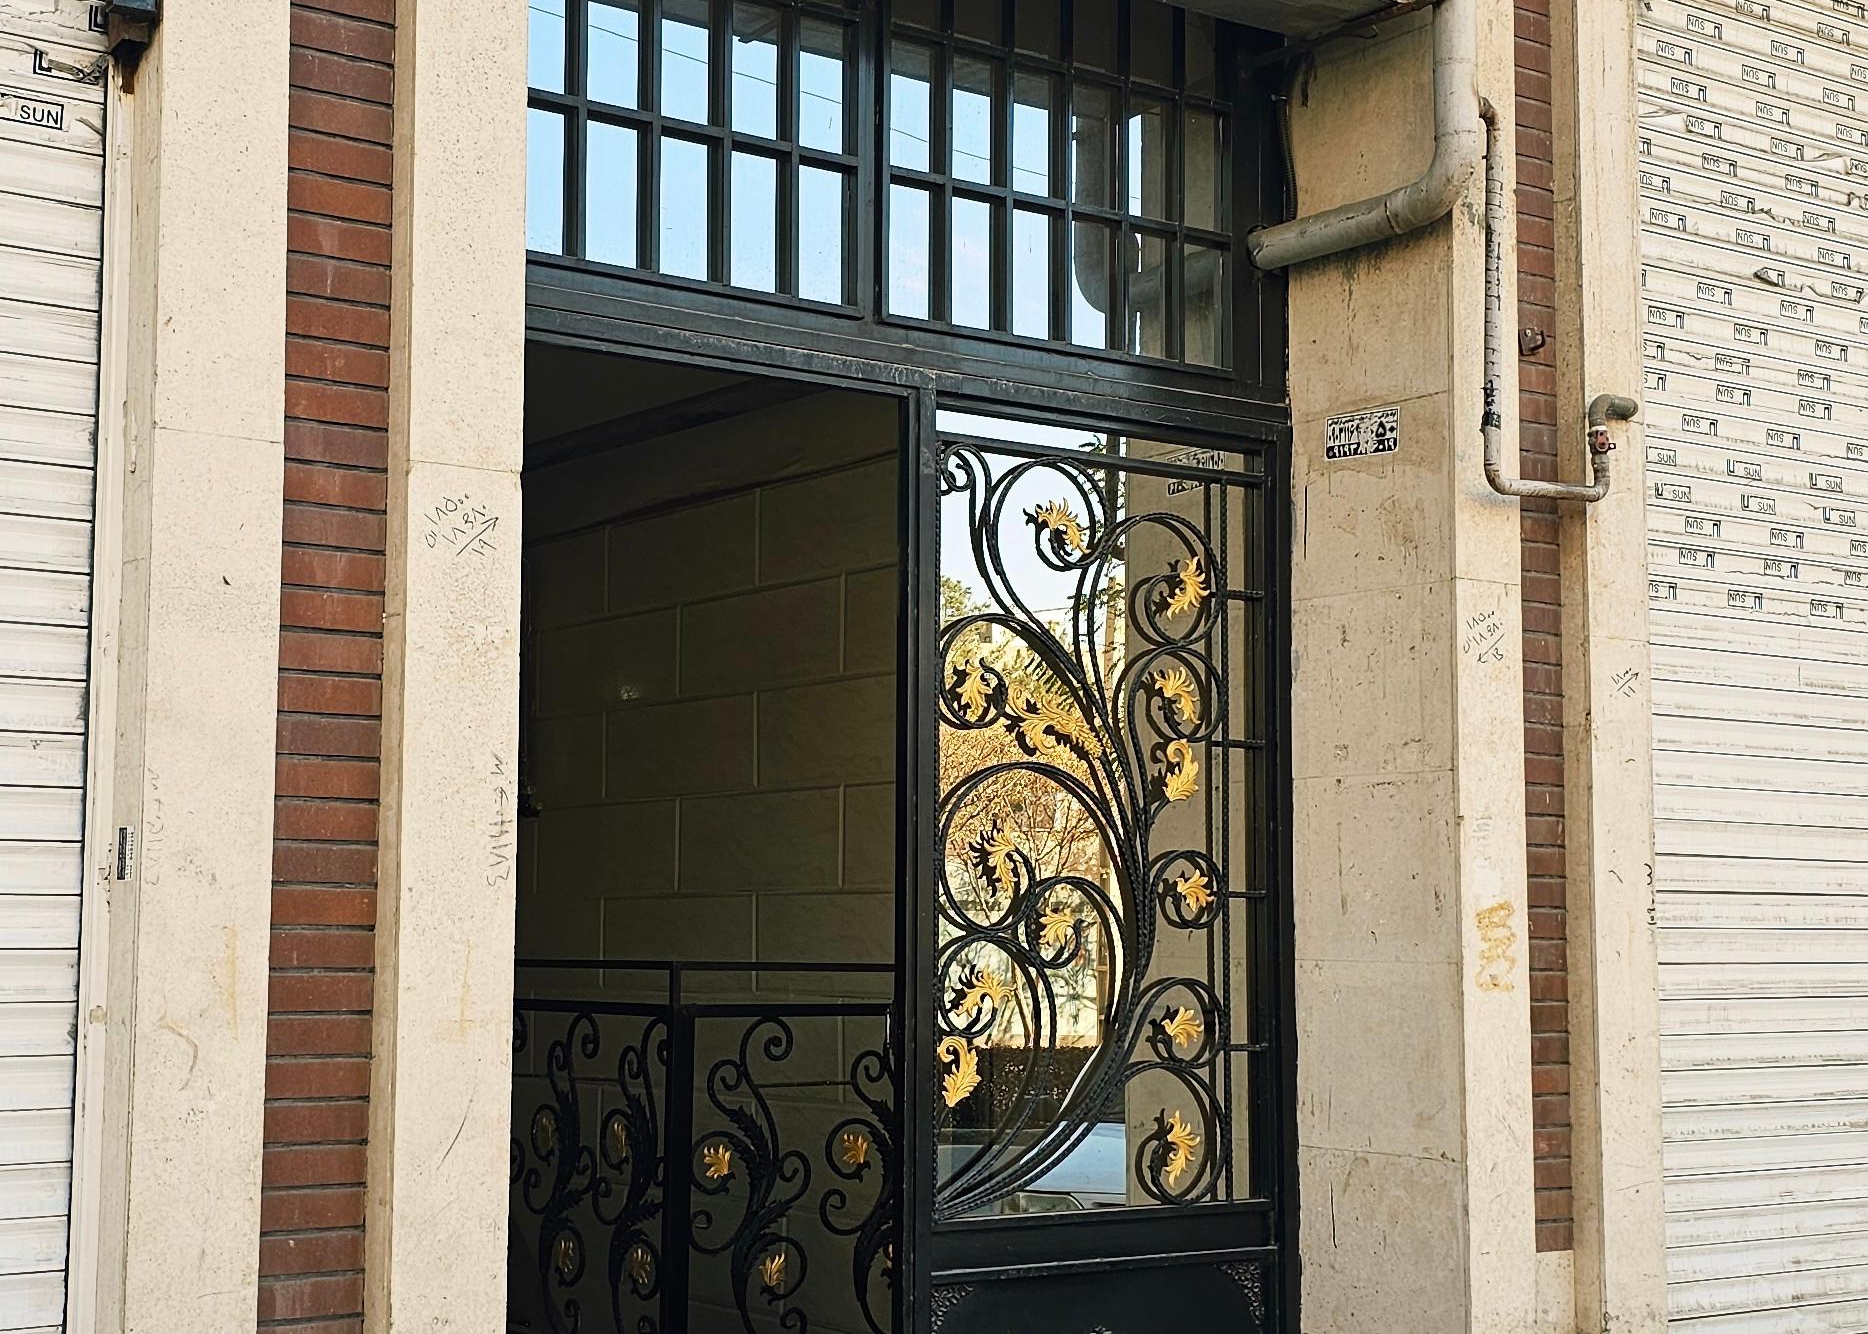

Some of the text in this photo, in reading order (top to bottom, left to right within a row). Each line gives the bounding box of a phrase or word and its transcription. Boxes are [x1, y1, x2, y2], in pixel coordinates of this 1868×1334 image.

[1737, 0, 1754, 13] SUN
[1689, 16, 1704, 30] SUN
[1819, 24, 1834, 38] SUN
[1658, 43, 1675, 56] SUN
[1773, 43, 1788, 56] SUN
[1743, 67, 1759, 80] SUN
[1672, 80, 1689, 93] SUN
[1824, 91, 1840, 103] SUN
[20, 104, 59, 125] SUN
[1757, 104, 1774, 116] SUN
[1688, 119, 1704, 131] SUN
[1838, 127, 1853, 138] SUN
[1772, 141, 1787, 153] SUN
[1703, 156, 1720, 168] SUN
[1640, 174, 1653, 186] SU
[1786, 177, 1803, 189] SUN
[1722, 193, 1739, 206] SUN
[1652, 210, 1669, 223] SUN
[1804, 213, 1820, 225] SUN
[1737, 232, 1754, 243] SUN
[1819, 250, 1834, 262] SUN
[1699, 285, 1715, 297] SUN
[1832, 285, 1848, 296] SUN
[1781, 304, 1798, 314] SUN
[1649, 310, 1666, 321] SUN
[1736, 327, 1752, 338] SUN
[1817, 344, 1832, 355] SUN
[1799, 374, 1815, 383] SUN
[1718, 389, 1734, 399] SUN
[1800, 403, 1816, 413] SUN
[1683, 418, 1700, 428] SUN
[1768, 433, 1784, 443] SUN
[1848, 446, 1863, 457] SUN
[1657, 453, 1675, 463] SUN
[1744, 468, 1760, 478] SUN
[1826, 480, 1841, 490] SUN
[1672, 490, 1690, 500] SUN
[1758, 502, 1774, 512] SUN
[1839, 514, 1855, 524] SUN
[1687, 520, 1703, 530] SUN
[1772, 530, 1787, 541] SUN
[1680, 550, 1697, 561] SUN
[1766, 561, 1782, 572] SUN
[1845, 572, 1861, 582] SUN
[1649, 583, 1659, 593] SU
[1729, 594, 1746, 603] SUN
[1812, 603, 1827, 613] SUN
